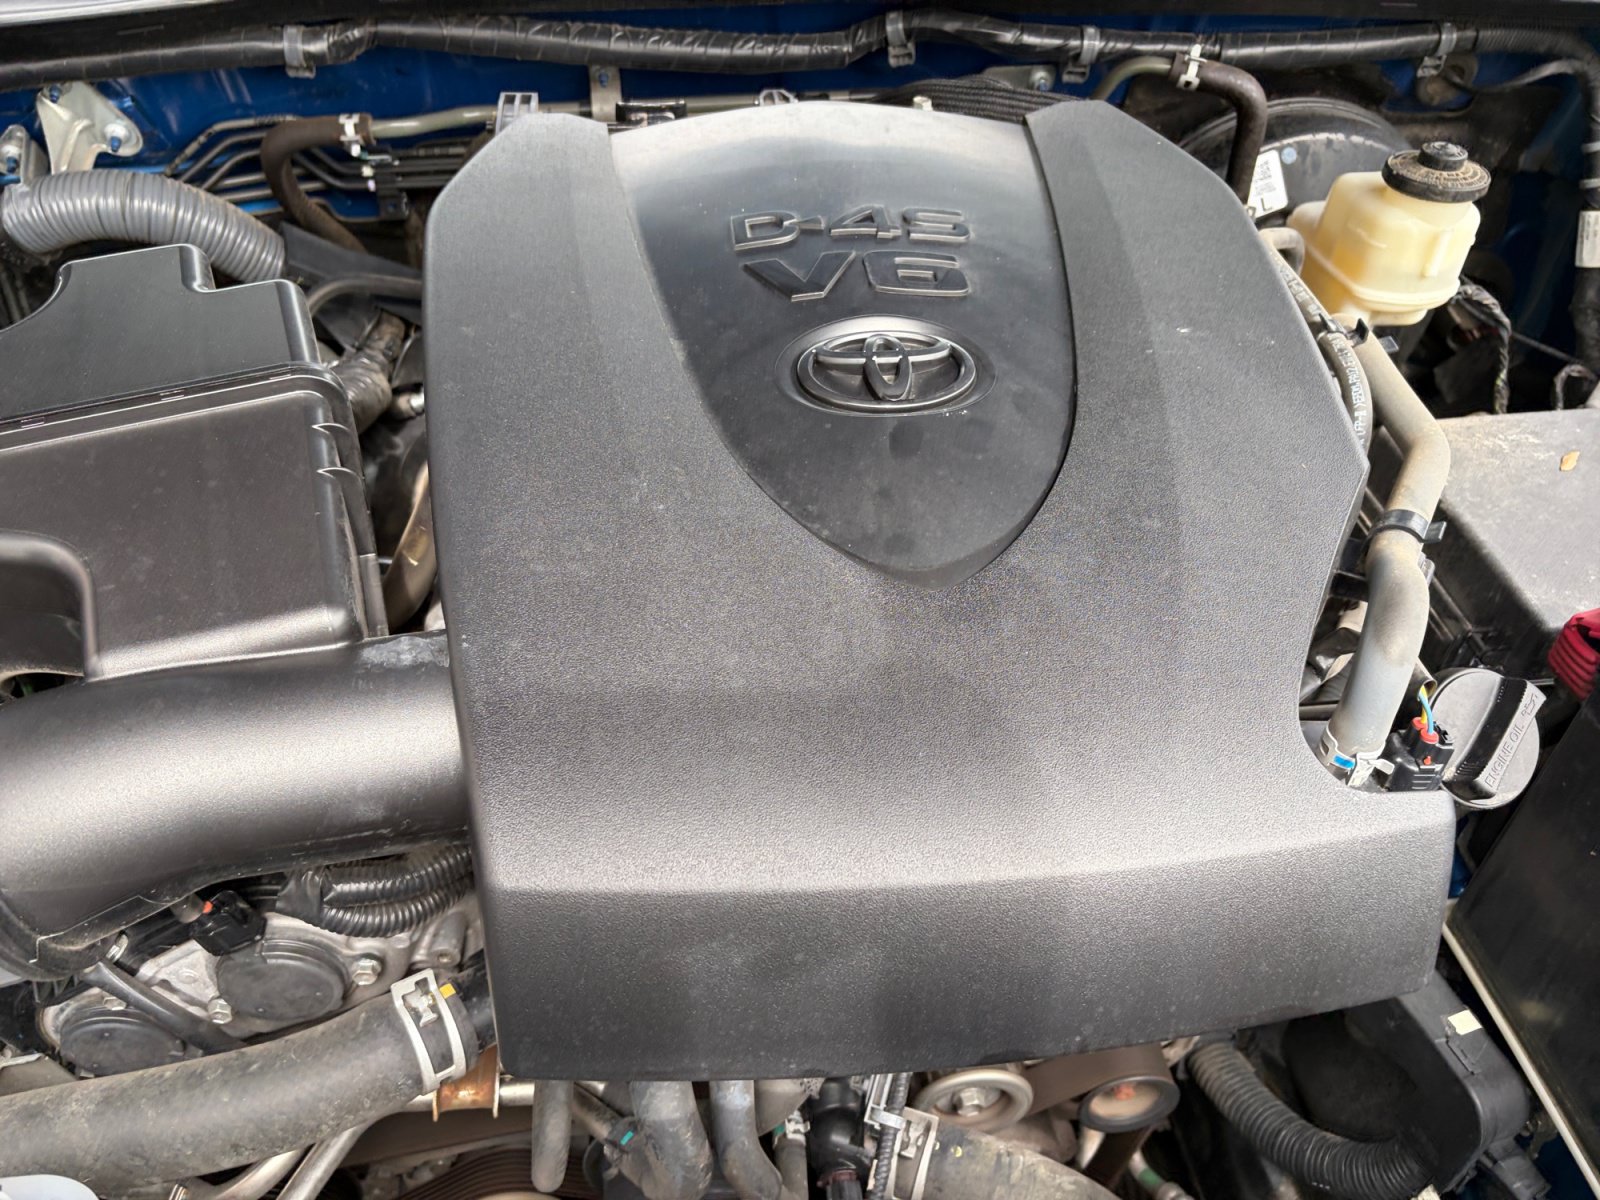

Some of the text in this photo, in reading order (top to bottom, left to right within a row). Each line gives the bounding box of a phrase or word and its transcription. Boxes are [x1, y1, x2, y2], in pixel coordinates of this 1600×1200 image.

[730, 203, 971, 250] D-4S
[742, 250, 971, 301] V6
[1484, 723, 1525, 789] ENGINE OIL
